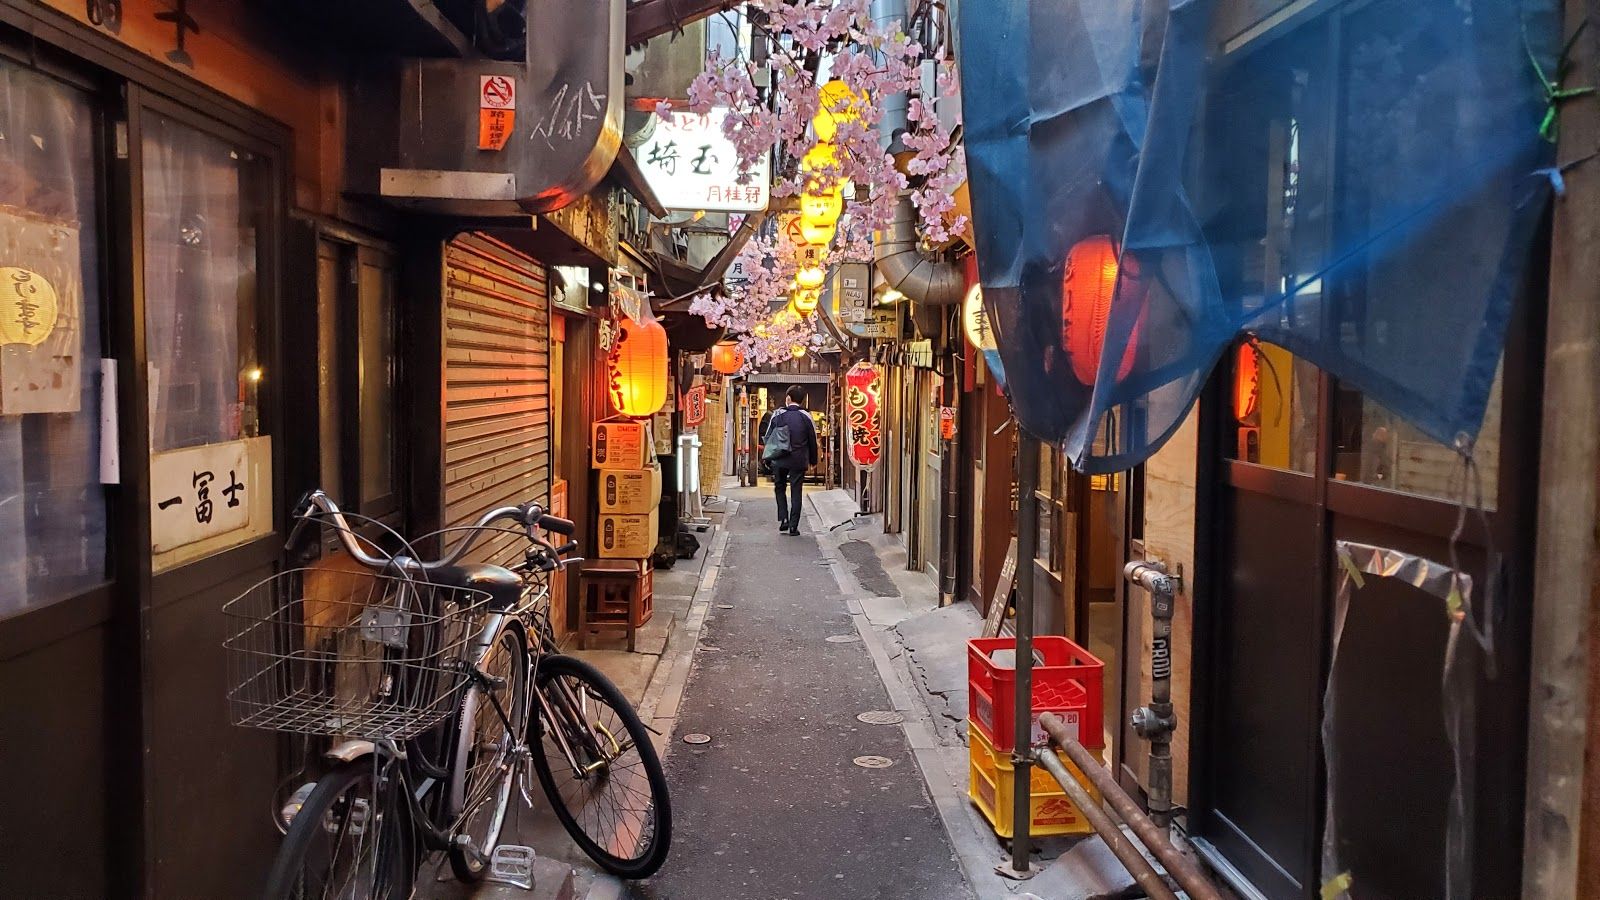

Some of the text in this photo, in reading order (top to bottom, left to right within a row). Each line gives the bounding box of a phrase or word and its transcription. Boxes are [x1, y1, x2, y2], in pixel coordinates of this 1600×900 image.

[706, 186, 761, 203] 月桂冠
[849, 386, 871, 446] もつ焼
[157, 470, 245, 524] 一富士
[1067, 714, 1078, 724] 20
